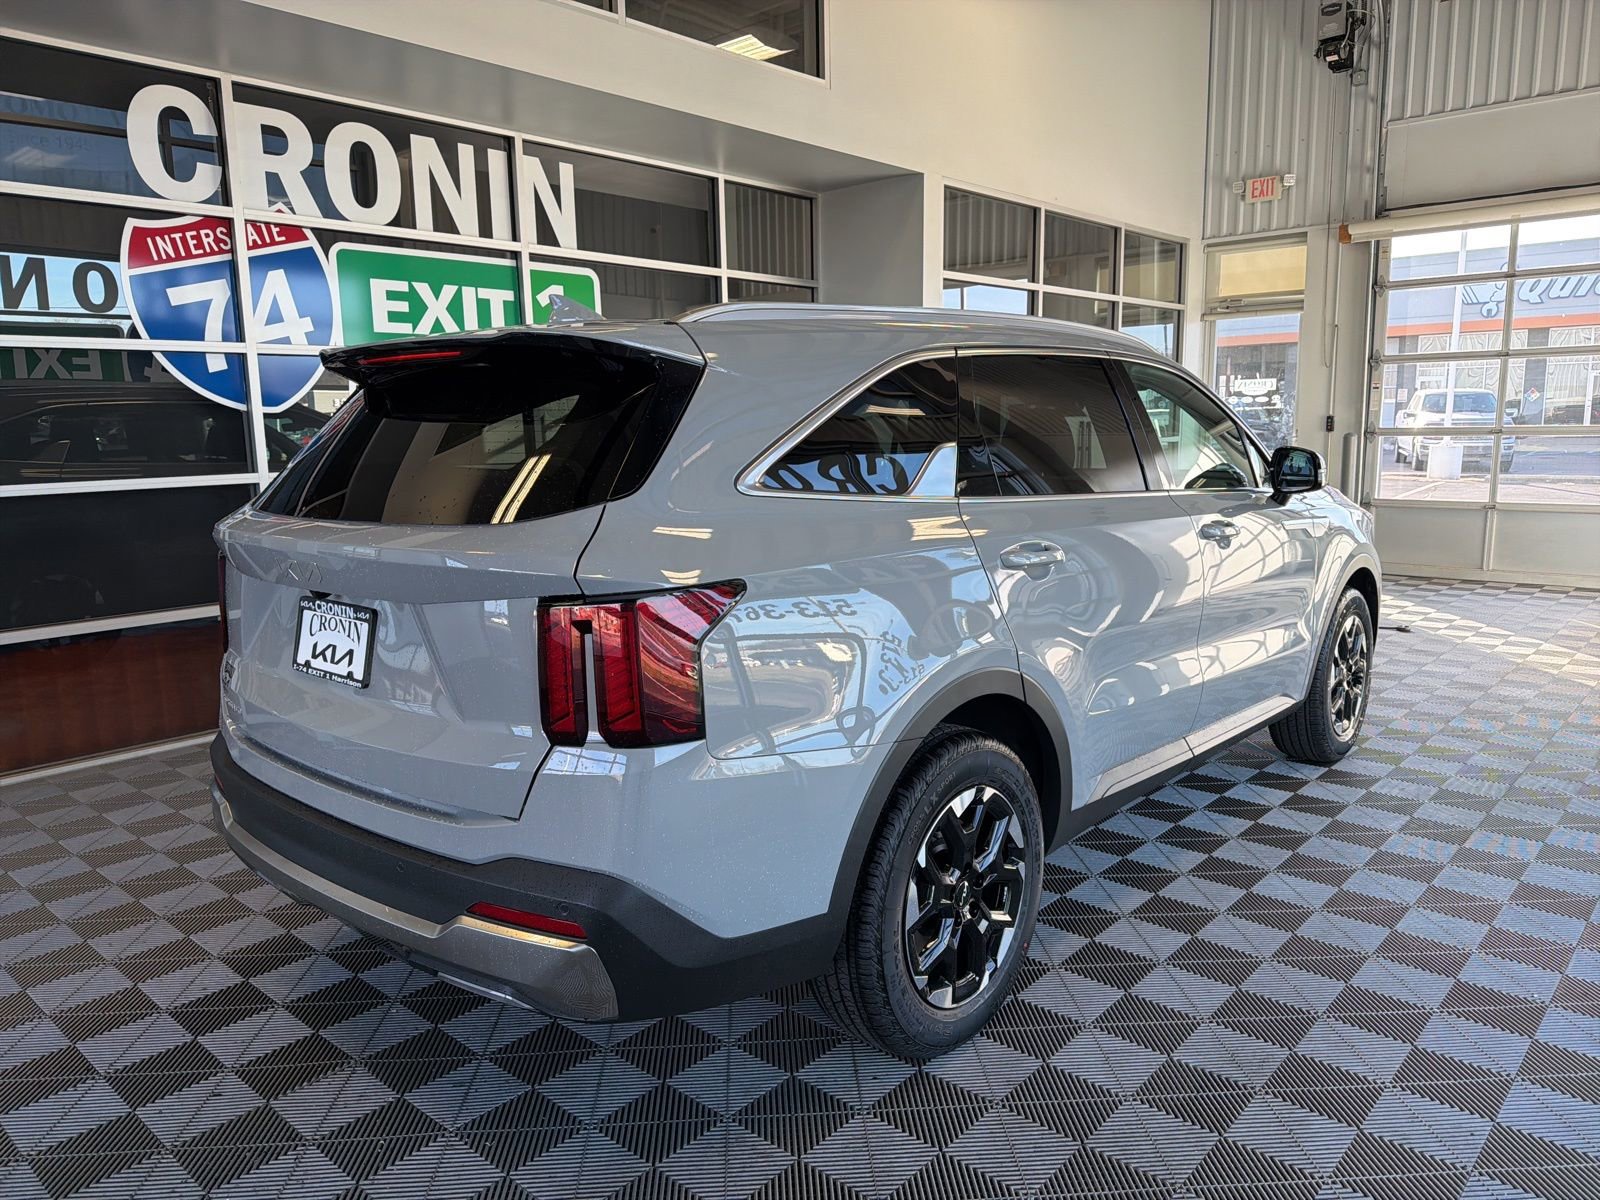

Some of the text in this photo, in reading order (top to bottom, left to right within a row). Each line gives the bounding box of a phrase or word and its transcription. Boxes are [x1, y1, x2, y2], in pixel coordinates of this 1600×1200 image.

[127, 83, 578, 250] CRONIN
[1251, 176, 1277, 200] EXIT
[166, 268, 314, 373] 74
[370, 277, 515, 335] EXIT
[314, 600, 354, 619] CRONIN
[309, 613, 363, 647] CRONIN
[311, 641, 354, 668] KIA
[308, 668, 325, 679] EXIT
[325, 673, 331, 681] 1
[331, 674, 362, 689] Harrison
